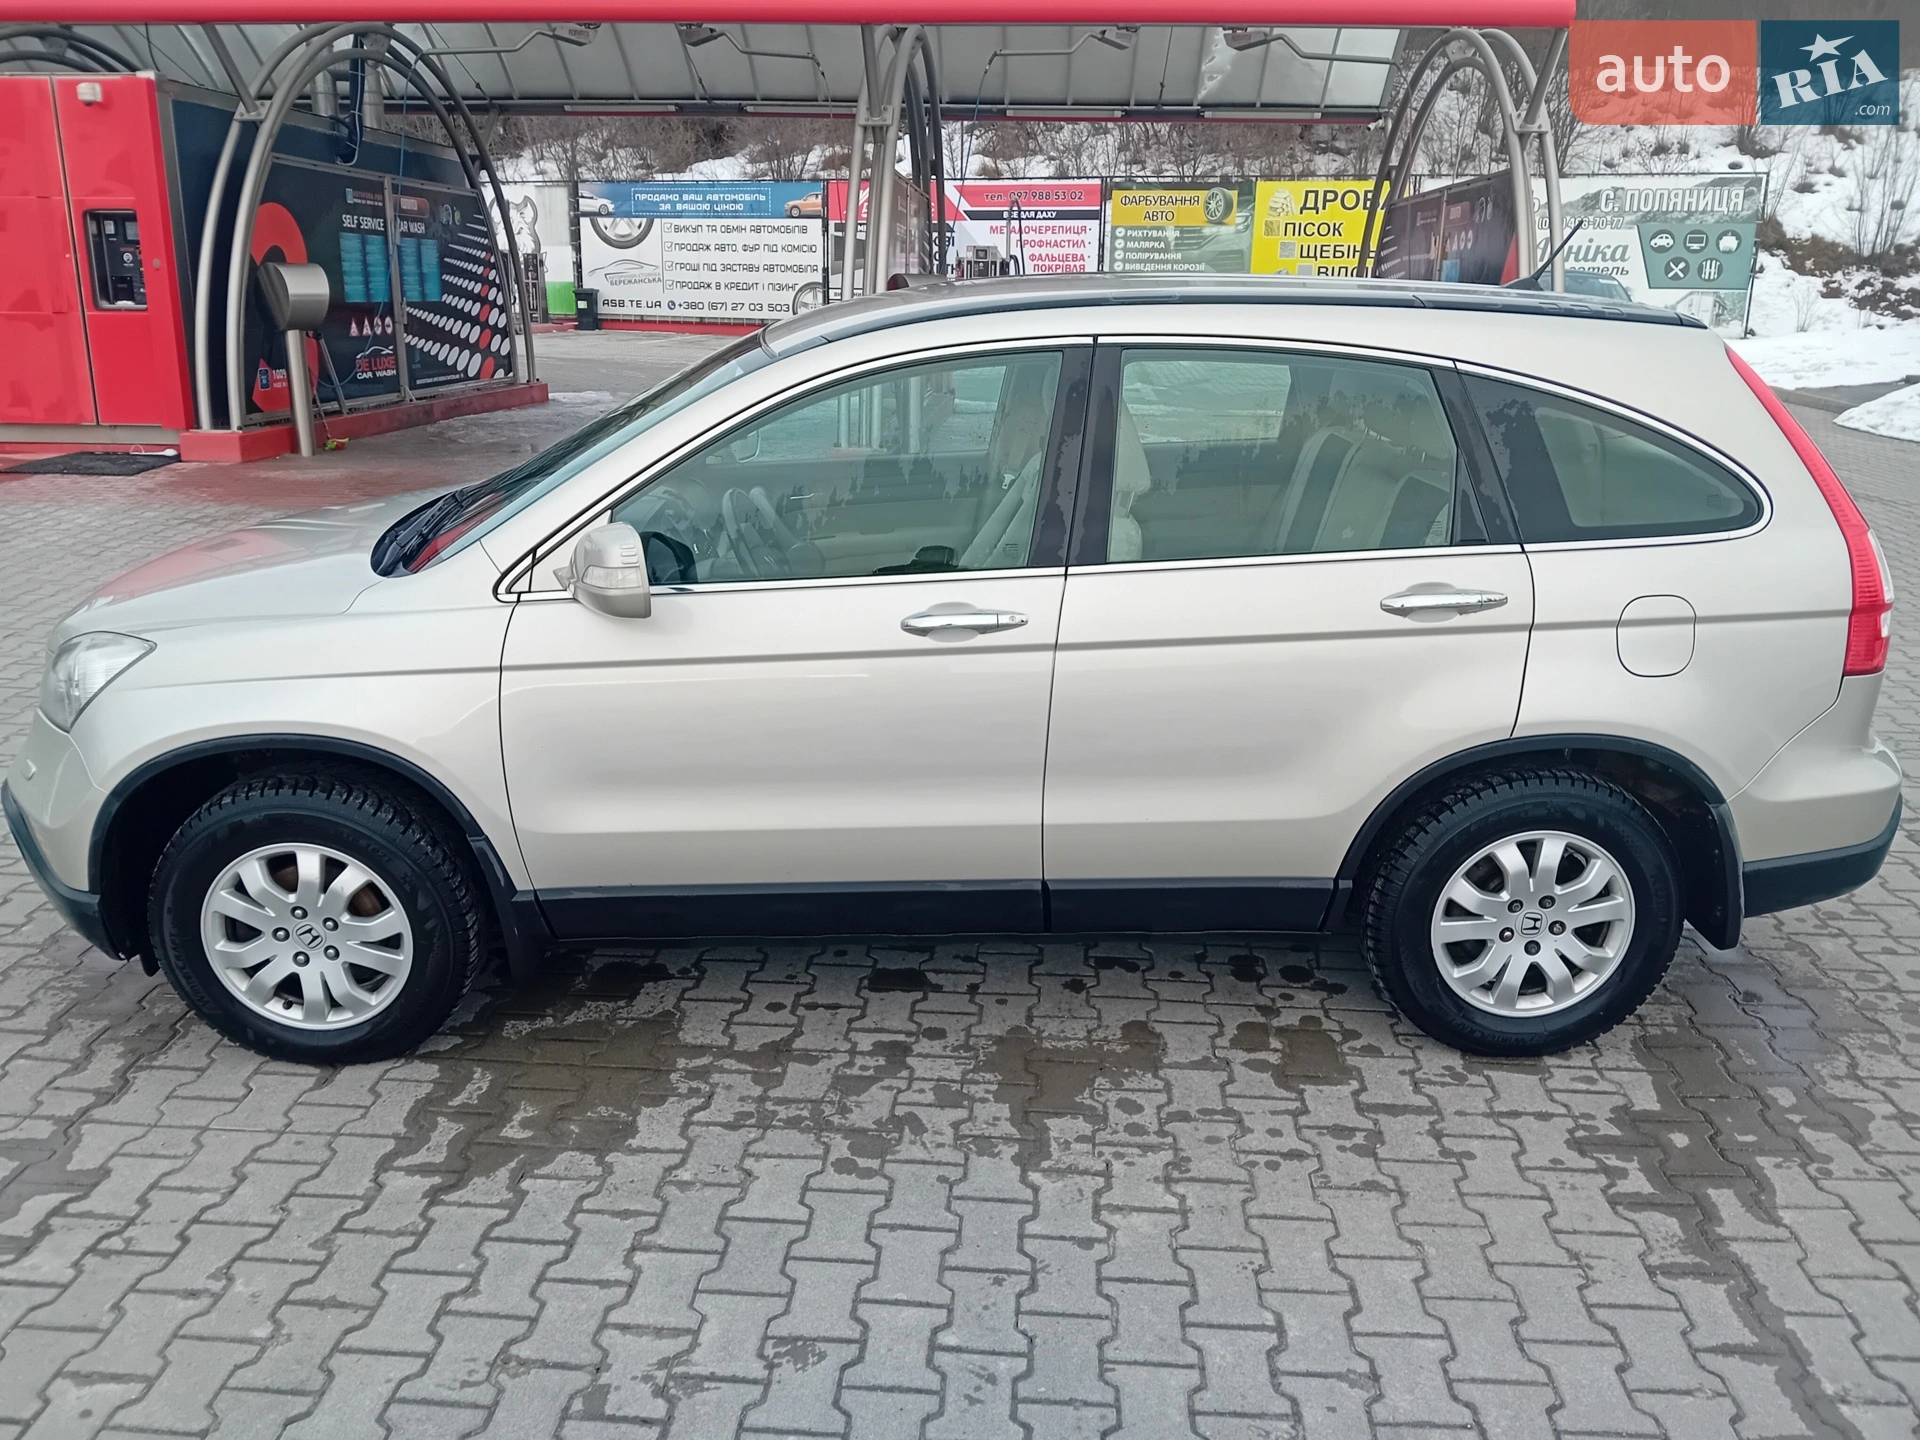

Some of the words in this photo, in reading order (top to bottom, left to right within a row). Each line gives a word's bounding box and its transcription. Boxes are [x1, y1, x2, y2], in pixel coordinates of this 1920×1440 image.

[635, 194, 679, 202] ПРОДАМО
[985, 192, 1006, 201] тел.
[1008, 190, 1028, 200] 097
[1031, 190, 1051, 200] 988
[1054, 190, 1068, 200] 53
[1070, 190, 1084, 200] 02
[1120, 195, 1200, 206] ФАРБУВАННЯ
[1300, 190, 1386, 214] ДРОВ
[1624, 188, 1745, 215] ПОЛЯНИЦЯ
[714, 203, 744, 211] ЦІНОЮ
[1036, 211, 1056, 219] ДАХУ
[1143, 210, 1175, 222] АВТО
[342, 214, 358, 228] SELF
[360, 216, 385, 231] SERVICE
[409, 221, 425, 234] WASH
[674, 224, 704, 233] ВИКУП
[706, 225, 717, 233] ТА
[720, 225, 747, 234] ОБМІН
[1284, 222, 1344, 236] ПІСОК
[674, 243, 712, 252] ПРОДАЖ
[714, 243, 739, 253] АВТО,
[742, 244, 760, 253] ФУР
[763, 244, 778, 253] ПІД
[782, 244, 818, 253] КОМІСІЮ
[1016, 239, 1086, 248] ПРОФНАСТИЛ
[1537, 236, 1631, 263] Аніка
[1029, 254, 1086, 263] ФАЛЬЦЕВА
[1126, 252, 1181, 260] ПОЛІРУВАННЯ
[675, 263, 700, 271] ГРОШІ
[703, 263, 717, 271] ПІД
[720, 263, 760, 272] ЗАСТАВУ
[1034, 264, 1086, 273] ПОКРІВЛЯ
[1124, 263, 1172, 271] ВИВЕДЕННЯ
[1173, 262, 1205, 271] КОРОЗІЇ
[610, 277, 662, 286] БЕРЕЖАНСЬКА
[675, 281, 712, 290] ПРОДАЖ
[715, 282, 721, 290] В
[724, 282, 759, 291] КРЕДИТ
[602, 299, 662, 308] ASB.TE.UA
[678, 301, 705, 310] +380
[708, 302, 727, 311] (67)
[731, 303, 745, 311] 27
[748, 303, 763, 311] 03
[768, 303, 790, 312] 503
[356, 358, 369, 371] DE
[371, 356, 396, 370] LUXE
[357, 372, 373, 380] CAR
[376, 370, 396, 378] WASH
